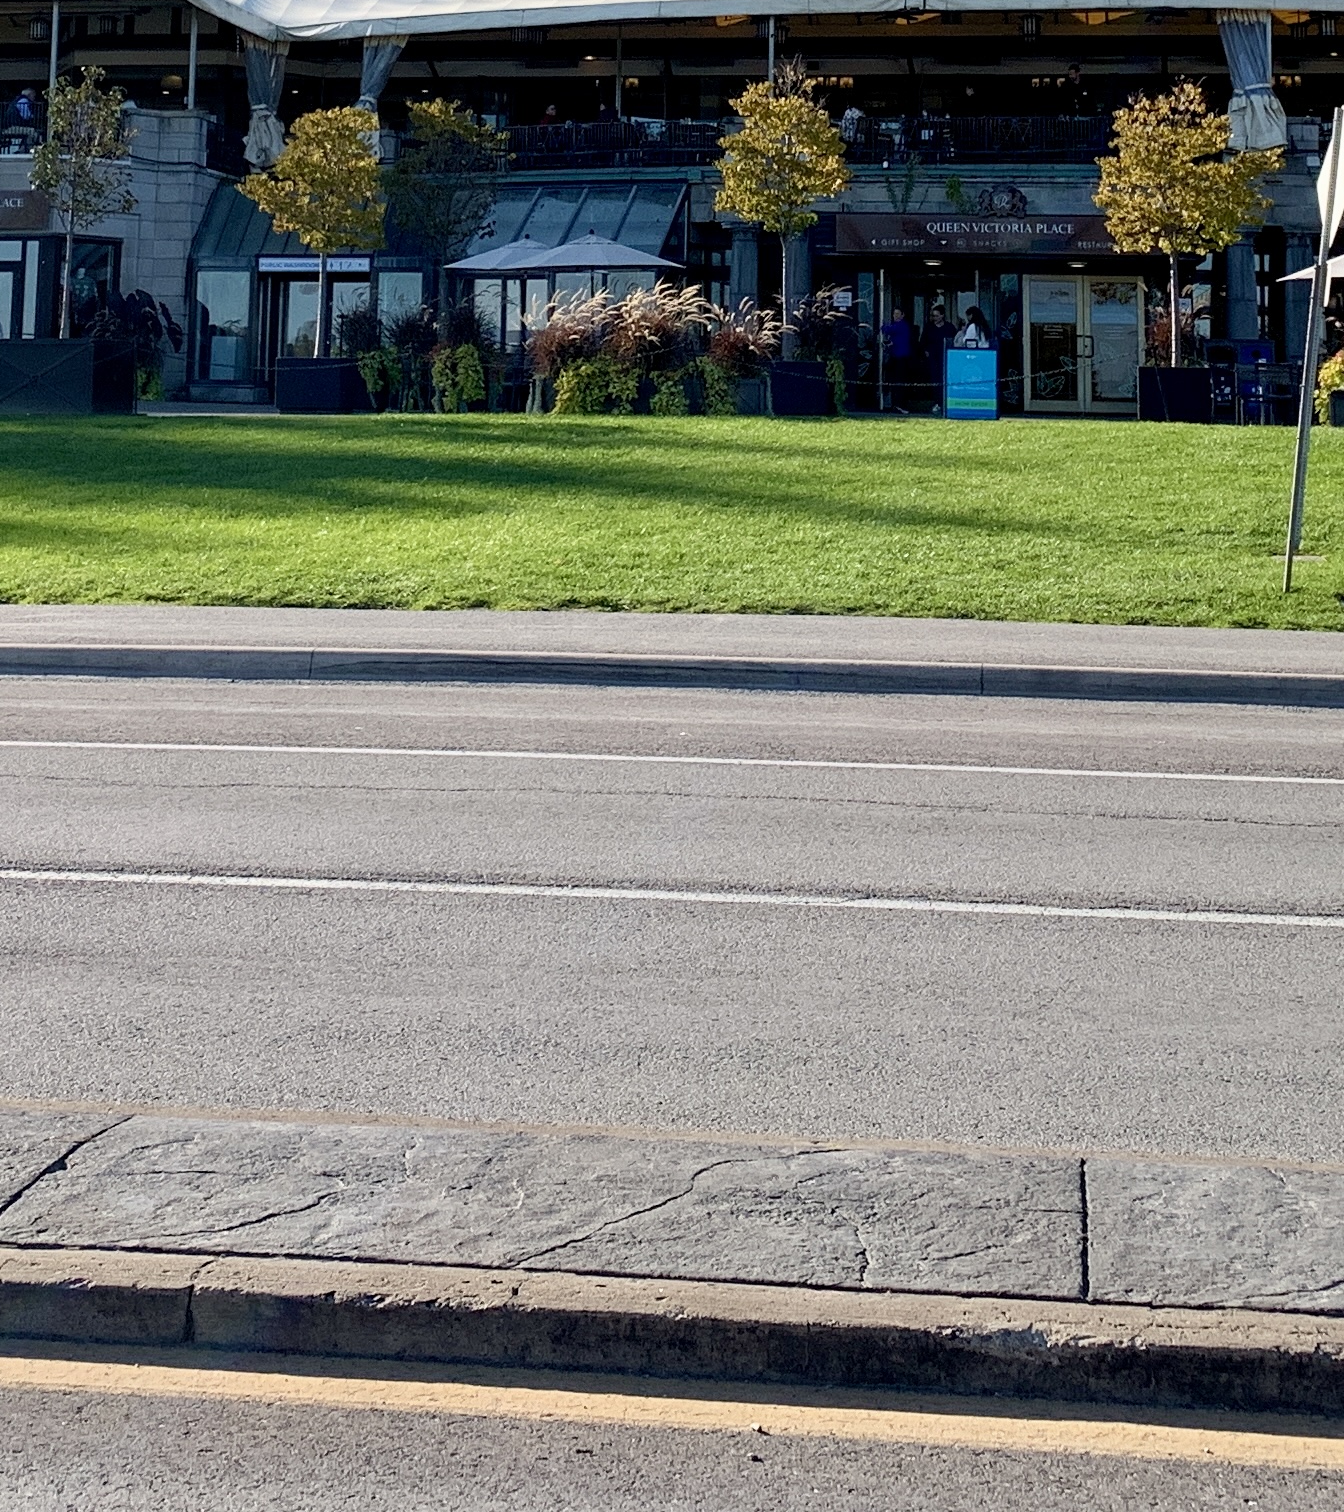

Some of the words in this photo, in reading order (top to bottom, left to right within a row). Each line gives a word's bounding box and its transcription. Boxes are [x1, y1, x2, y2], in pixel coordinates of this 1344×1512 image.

[926, 222, 970, 235] QUEEN
[972, 222, 1032, 234] VICTORIA
[1036, 223, 1075, 234] PLACE
[880, 238, 899, 246] GIFT
[902, 238, 926, 246] SHOP
[1077, 241, 1114, 249] RESTAUR
